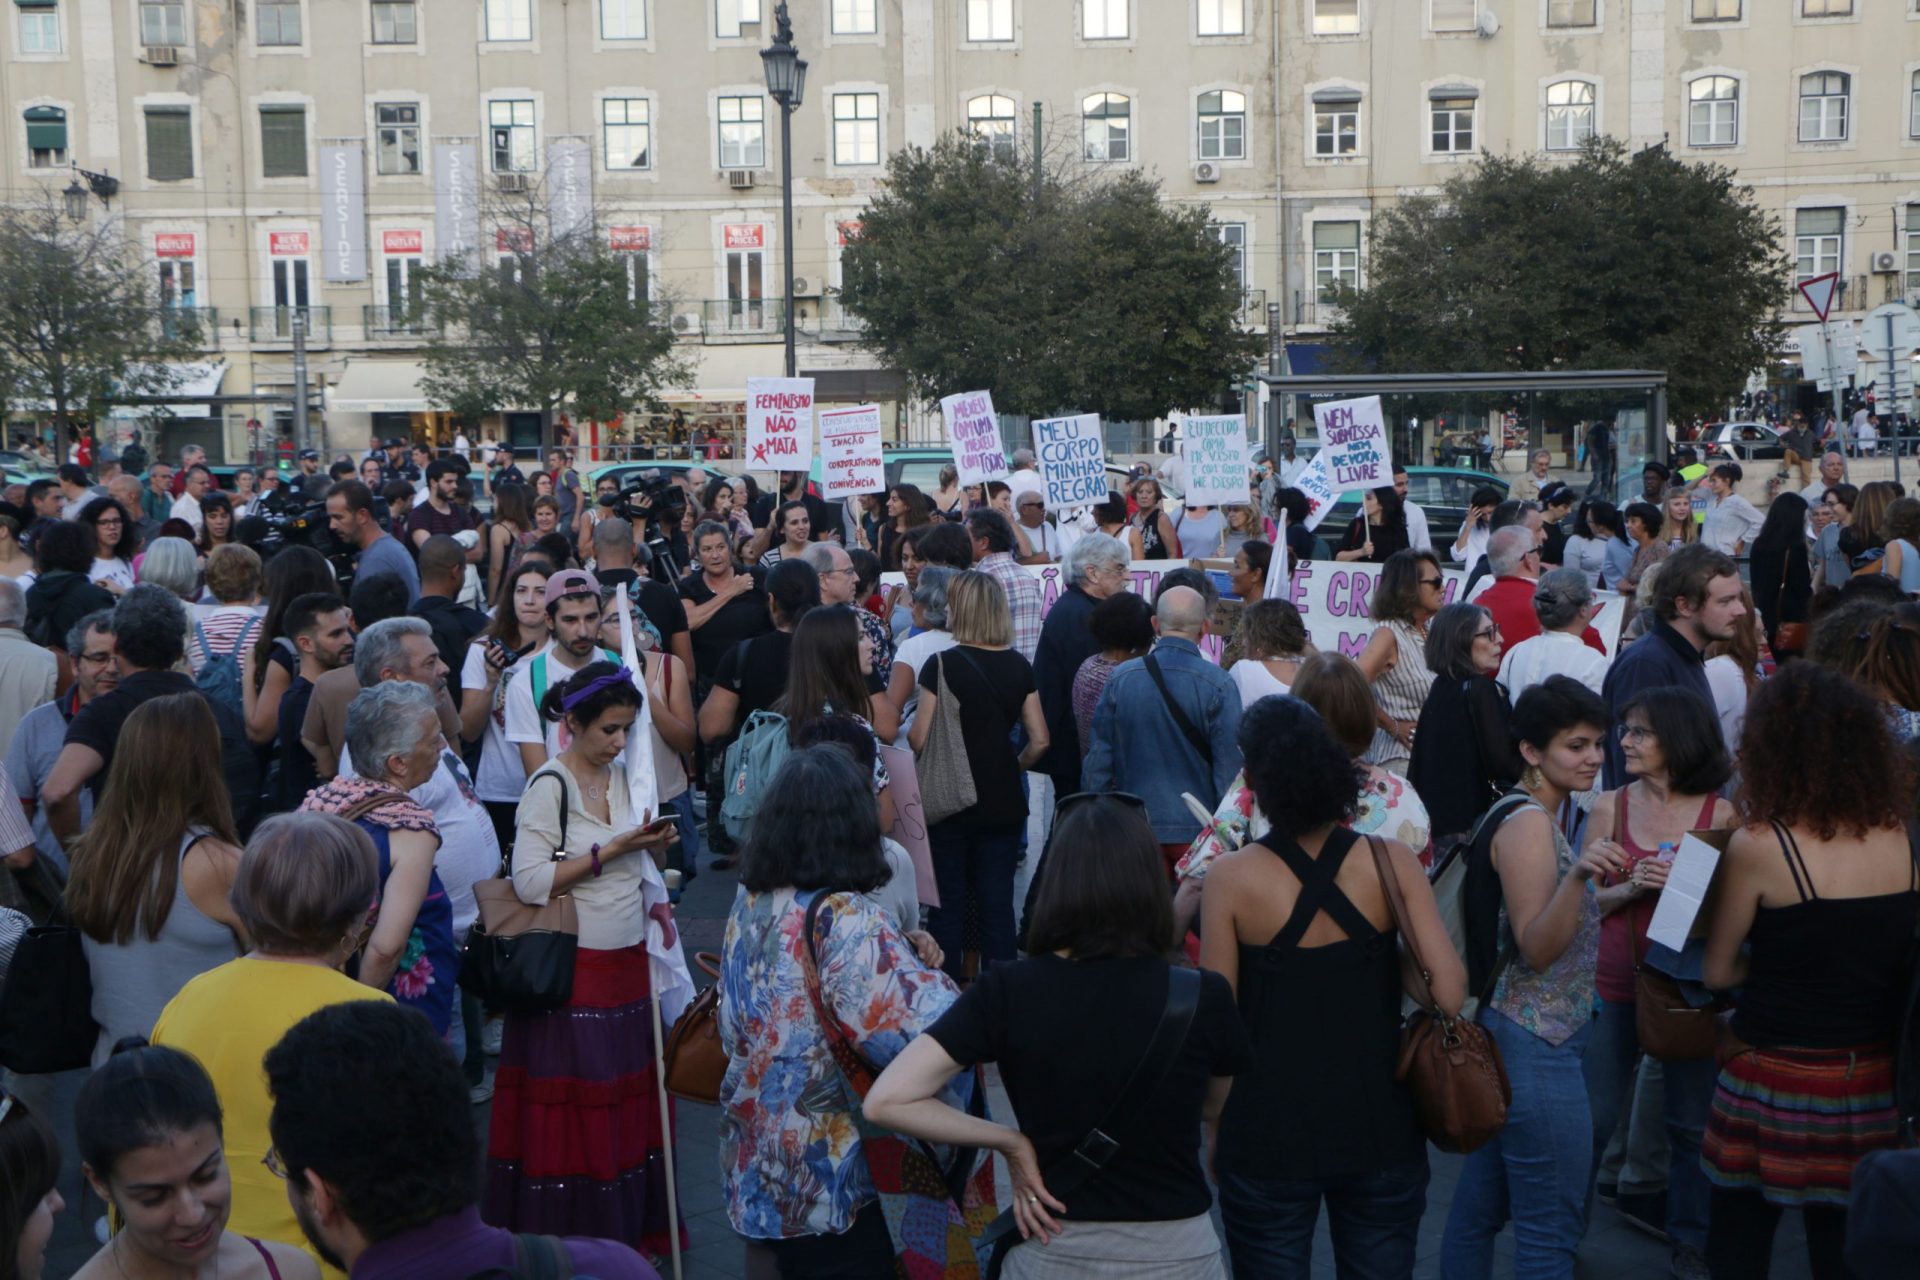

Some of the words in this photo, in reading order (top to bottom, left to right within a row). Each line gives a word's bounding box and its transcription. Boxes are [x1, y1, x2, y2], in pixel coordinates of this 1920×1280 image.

[335, 152, 351, 275] SEASIDE
[449, 151, 464, 254] SEASID
[756, 393, 811, 410] FEMINISMO
[953, 397, 987, 419] MEXEU
[954, 421, 974, 440] COM
[974, 416, 993, 437] UMA
[1323, 407, 1354, 430] NEM
[831, 435, 864, 447] INAÇÃO
[1038, 419, 1079, 442] MEU
[1326, 424, 1381, 446] SUBMISSA
[766, 437, 798, 454] MATA
[964, 434, 995, 453] MEXEU
[1041, 437, 1100, 463] CORPO
[1347, 440, 1372, 453] NEM
[979, 451, 1006, 475] TODAS
[1045, 458, 1104, 481] MINHAS
[1337, 463, 1380, 485] LIVRE
[1048, 475, 1108, 504] REGRAS
